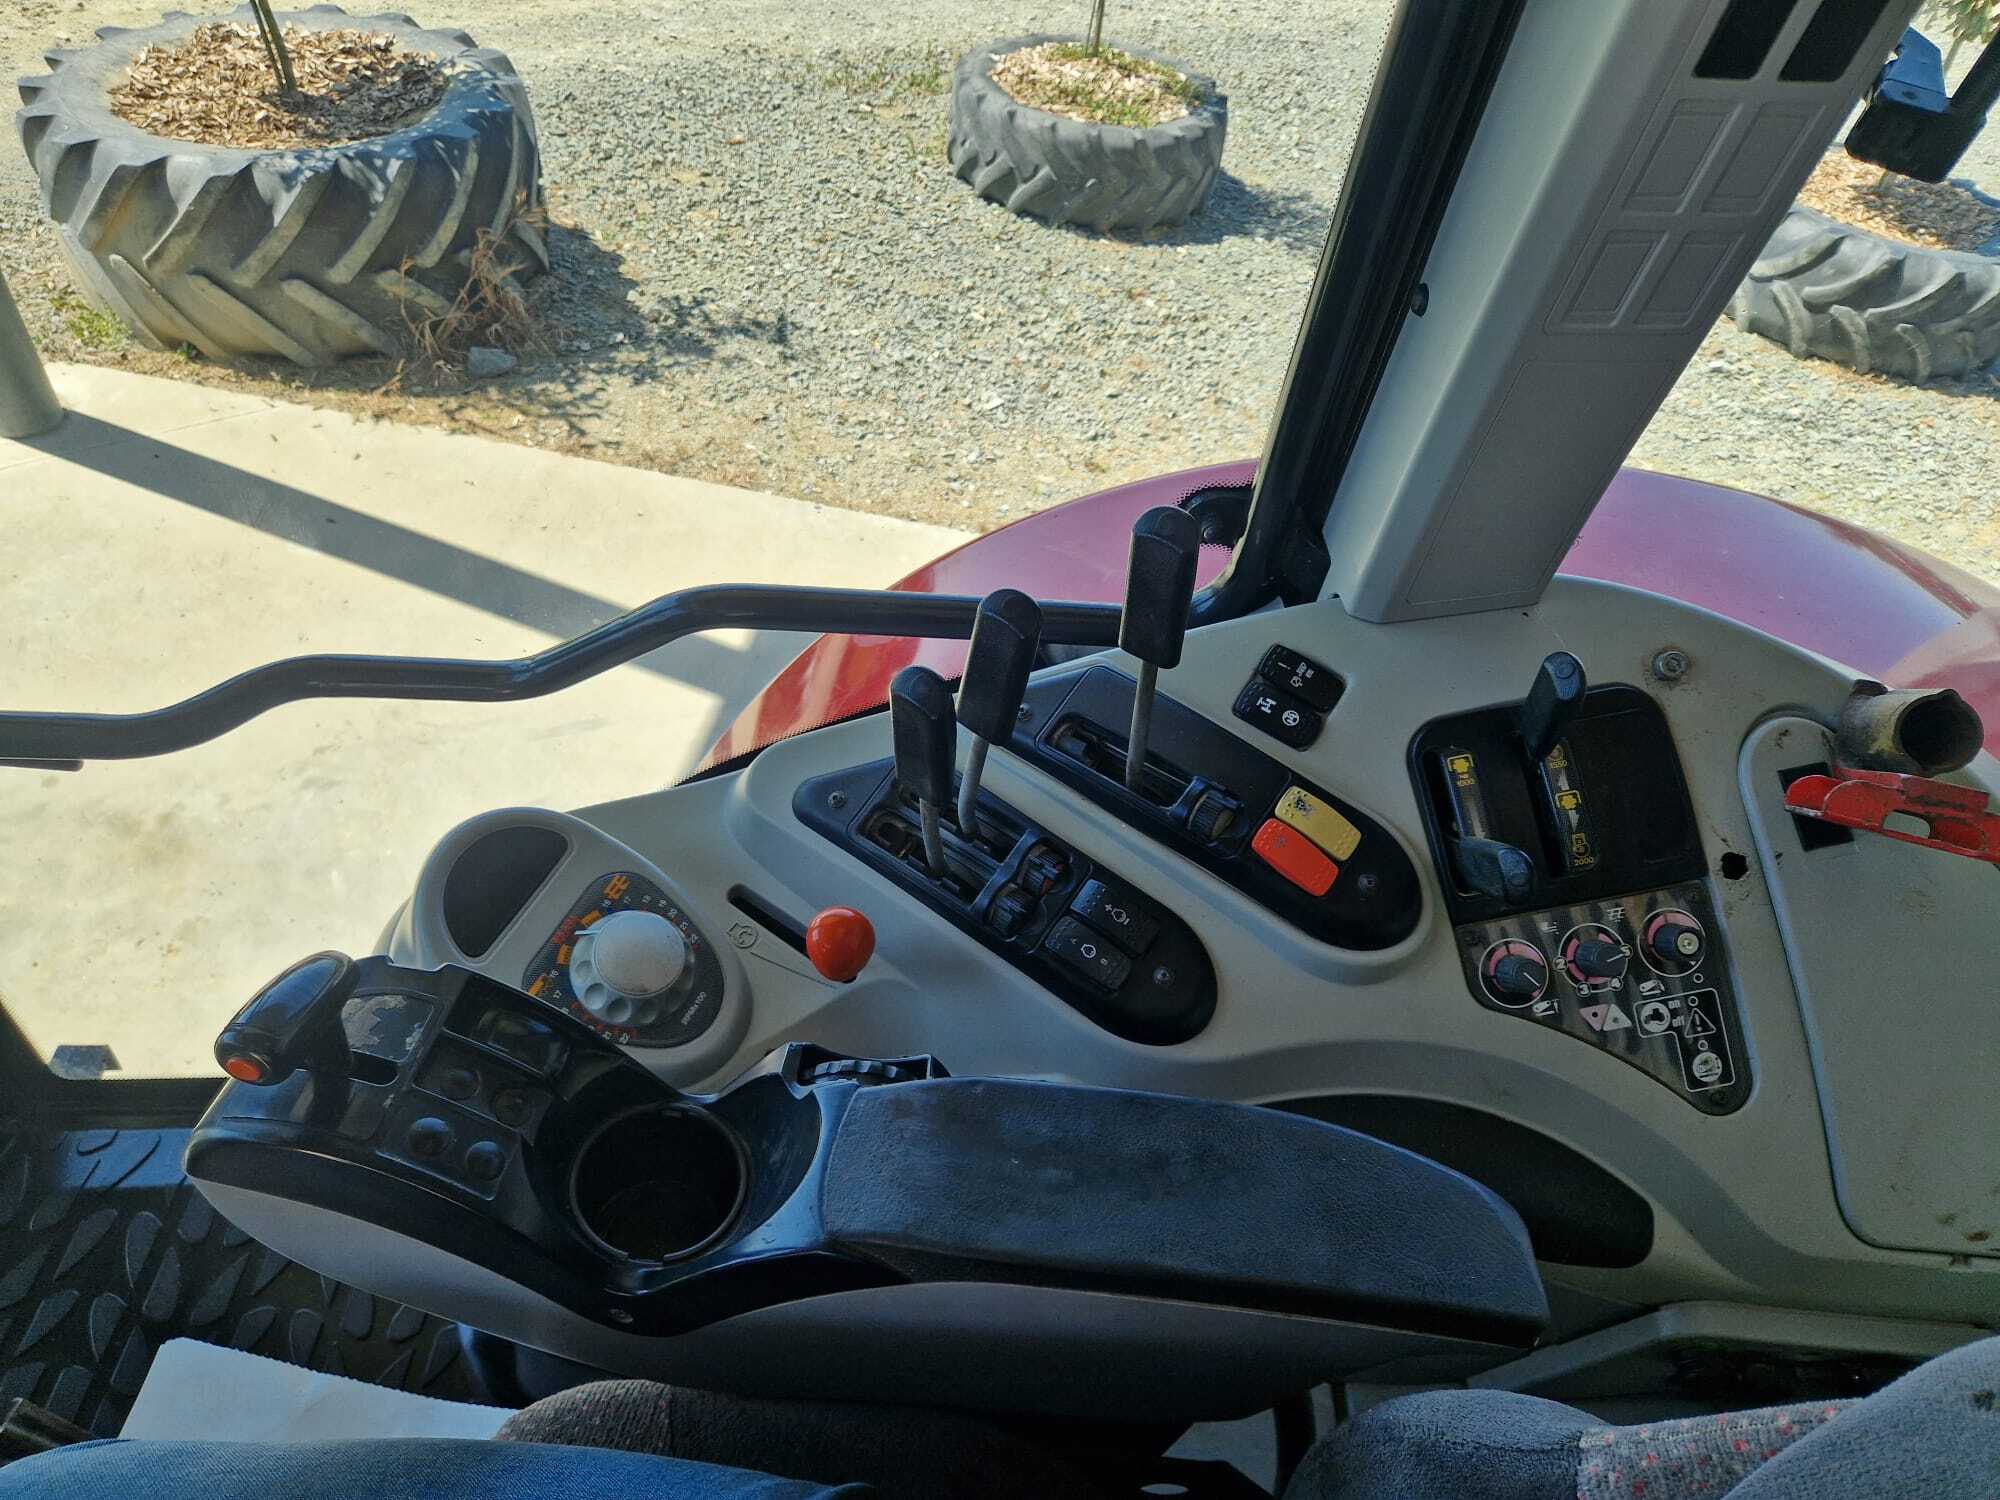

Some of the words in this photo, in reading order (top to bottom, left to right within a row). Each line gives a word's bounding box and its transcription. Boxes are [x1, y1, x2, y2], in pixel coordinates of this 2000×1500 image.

[1573, 856, 1594, 866] 2000
[1620, 945, 1630, 955] 5
[1555, 959, 1565, 969] 2
[1580, 983, 1589, 994] 3
[1611, 979, 1620, 988] 4
[1667, 999, 1681, 1009] on
[1672, 1015, 1685, 1027] off
